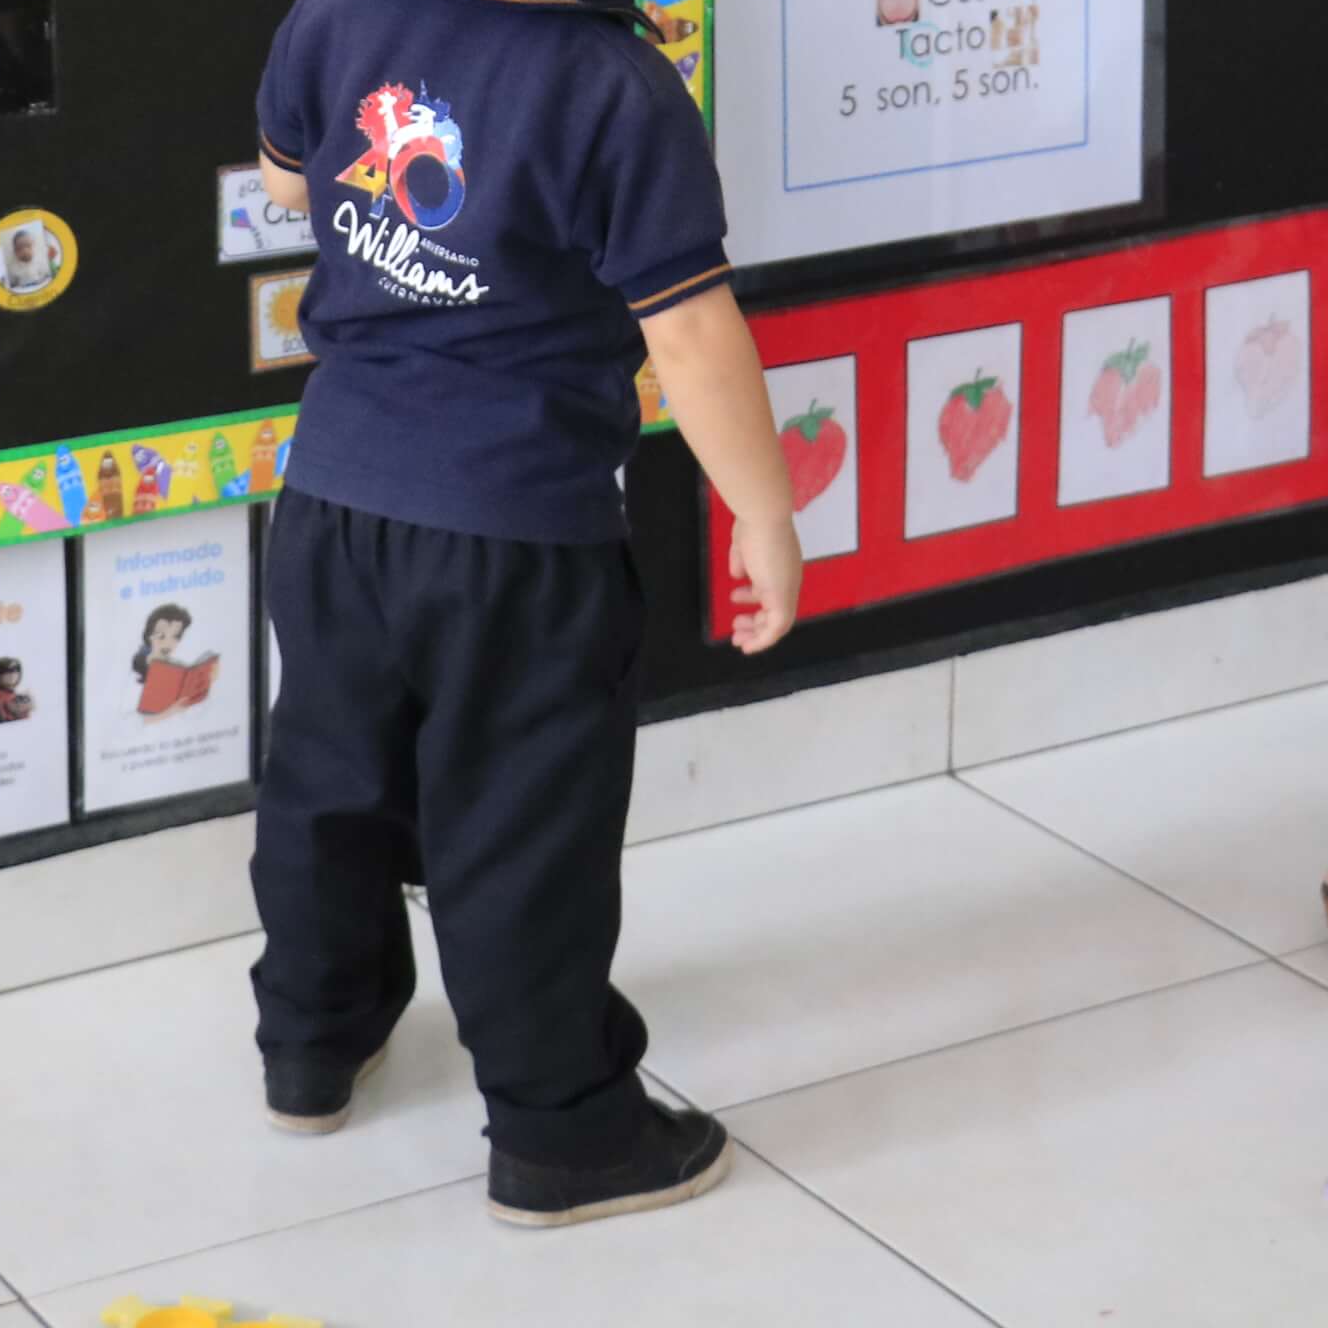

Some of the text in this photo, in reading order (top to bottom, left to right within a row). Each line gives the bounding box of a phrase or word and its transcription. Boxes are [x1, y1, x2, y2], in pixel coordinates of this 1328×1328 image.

[894, 22, 986, 60] Tacto
[838, 66, 1040, 117] 5 son, 5 son.
[332, 199, 490, 301] Williams
[115, 540, 223, 573] Informado
